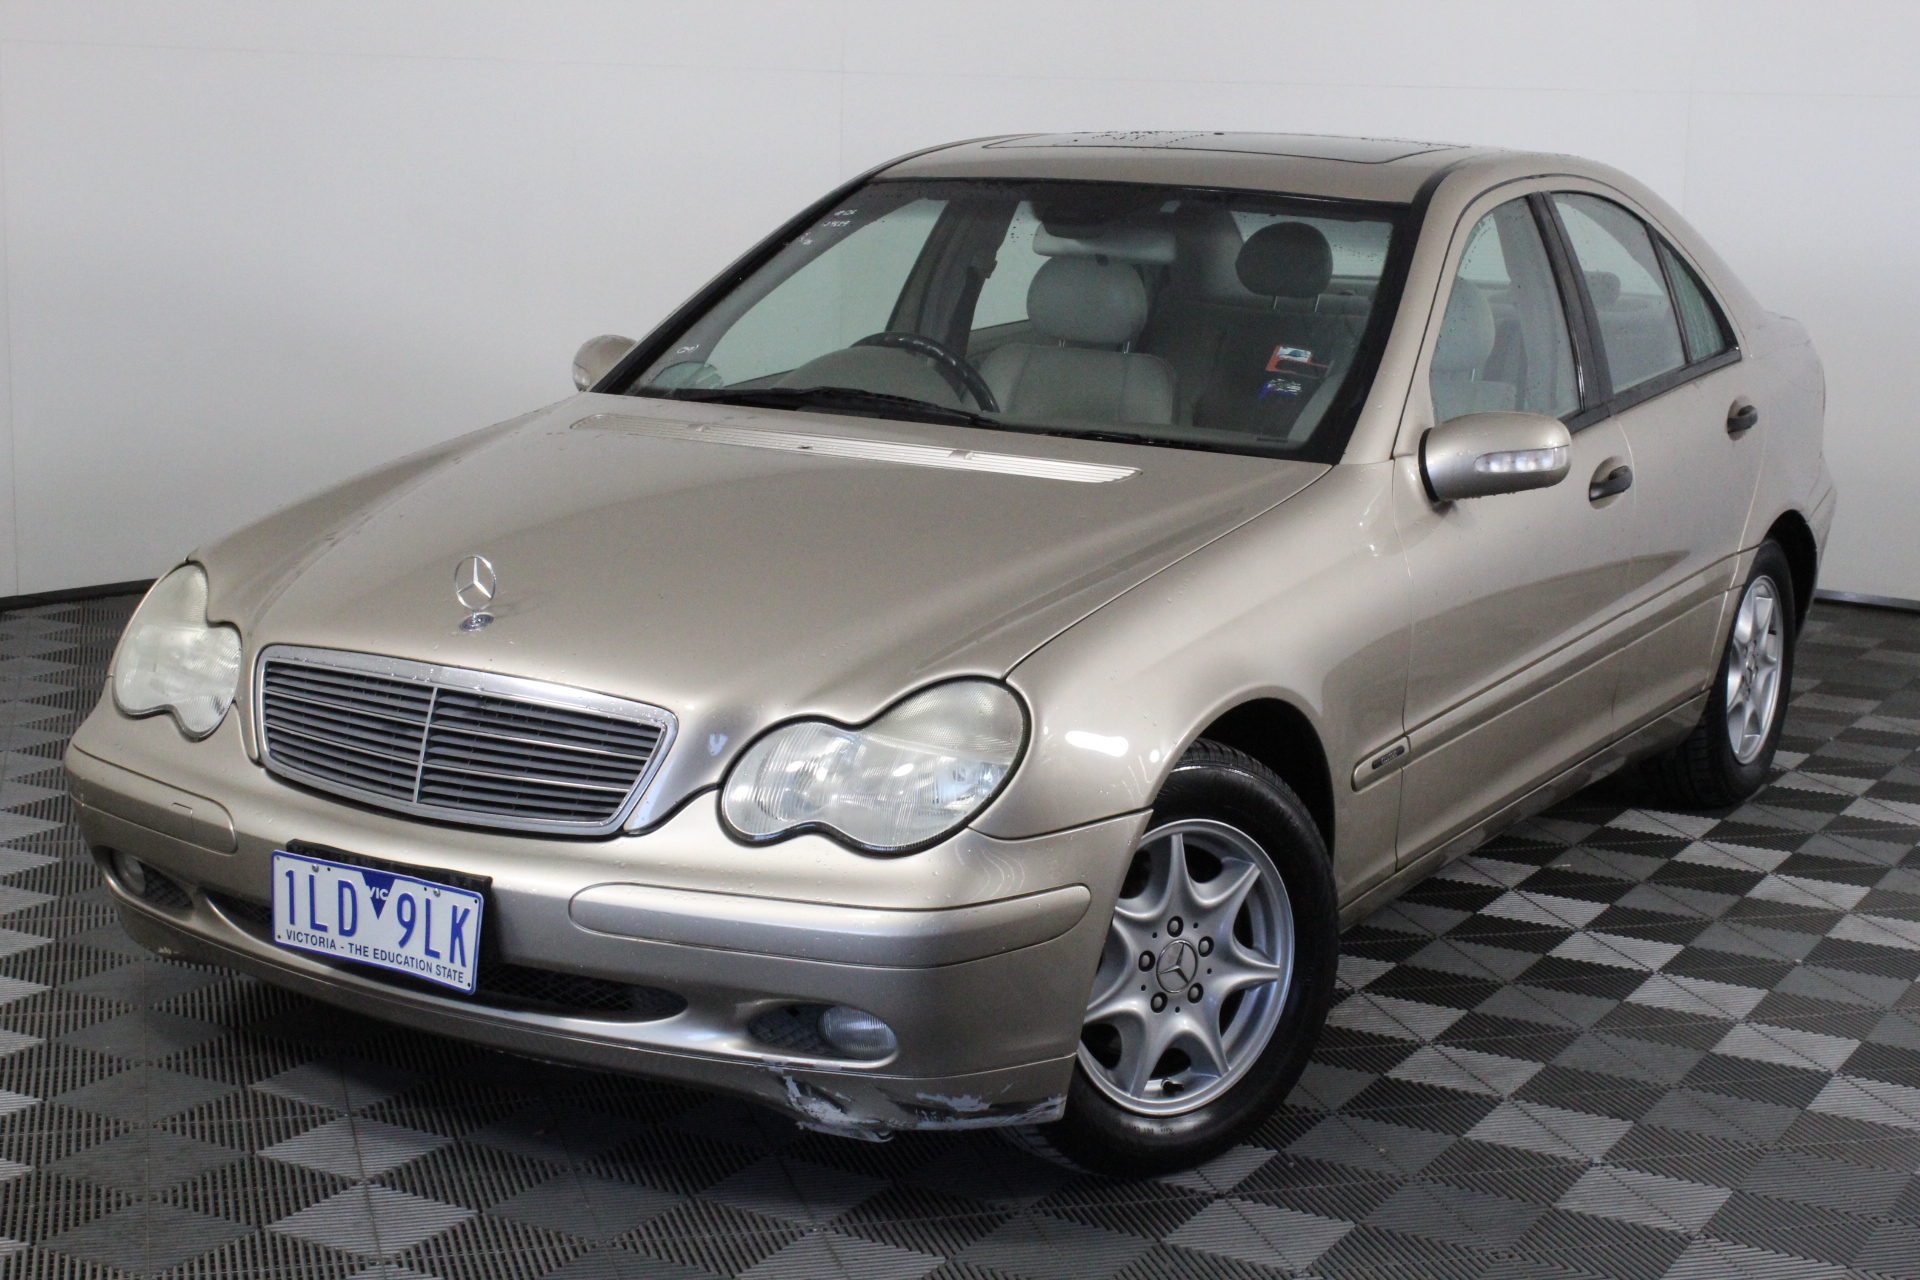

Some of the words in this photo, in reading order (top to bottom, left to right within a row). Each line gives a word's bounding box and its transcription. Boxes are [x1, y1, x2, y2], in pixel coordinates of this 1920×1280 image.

[285, 869, 358, 937] 1LD
[396, 892, 470, 967] 9LK
[369, 885, 389, 900] VIC
[286, 929, 337, 950] VICTORIA
[348, 942, 369, 958] THE
[373, 949, 432, 973] EDUCATION
[435, 964, 464, 983] STATE
